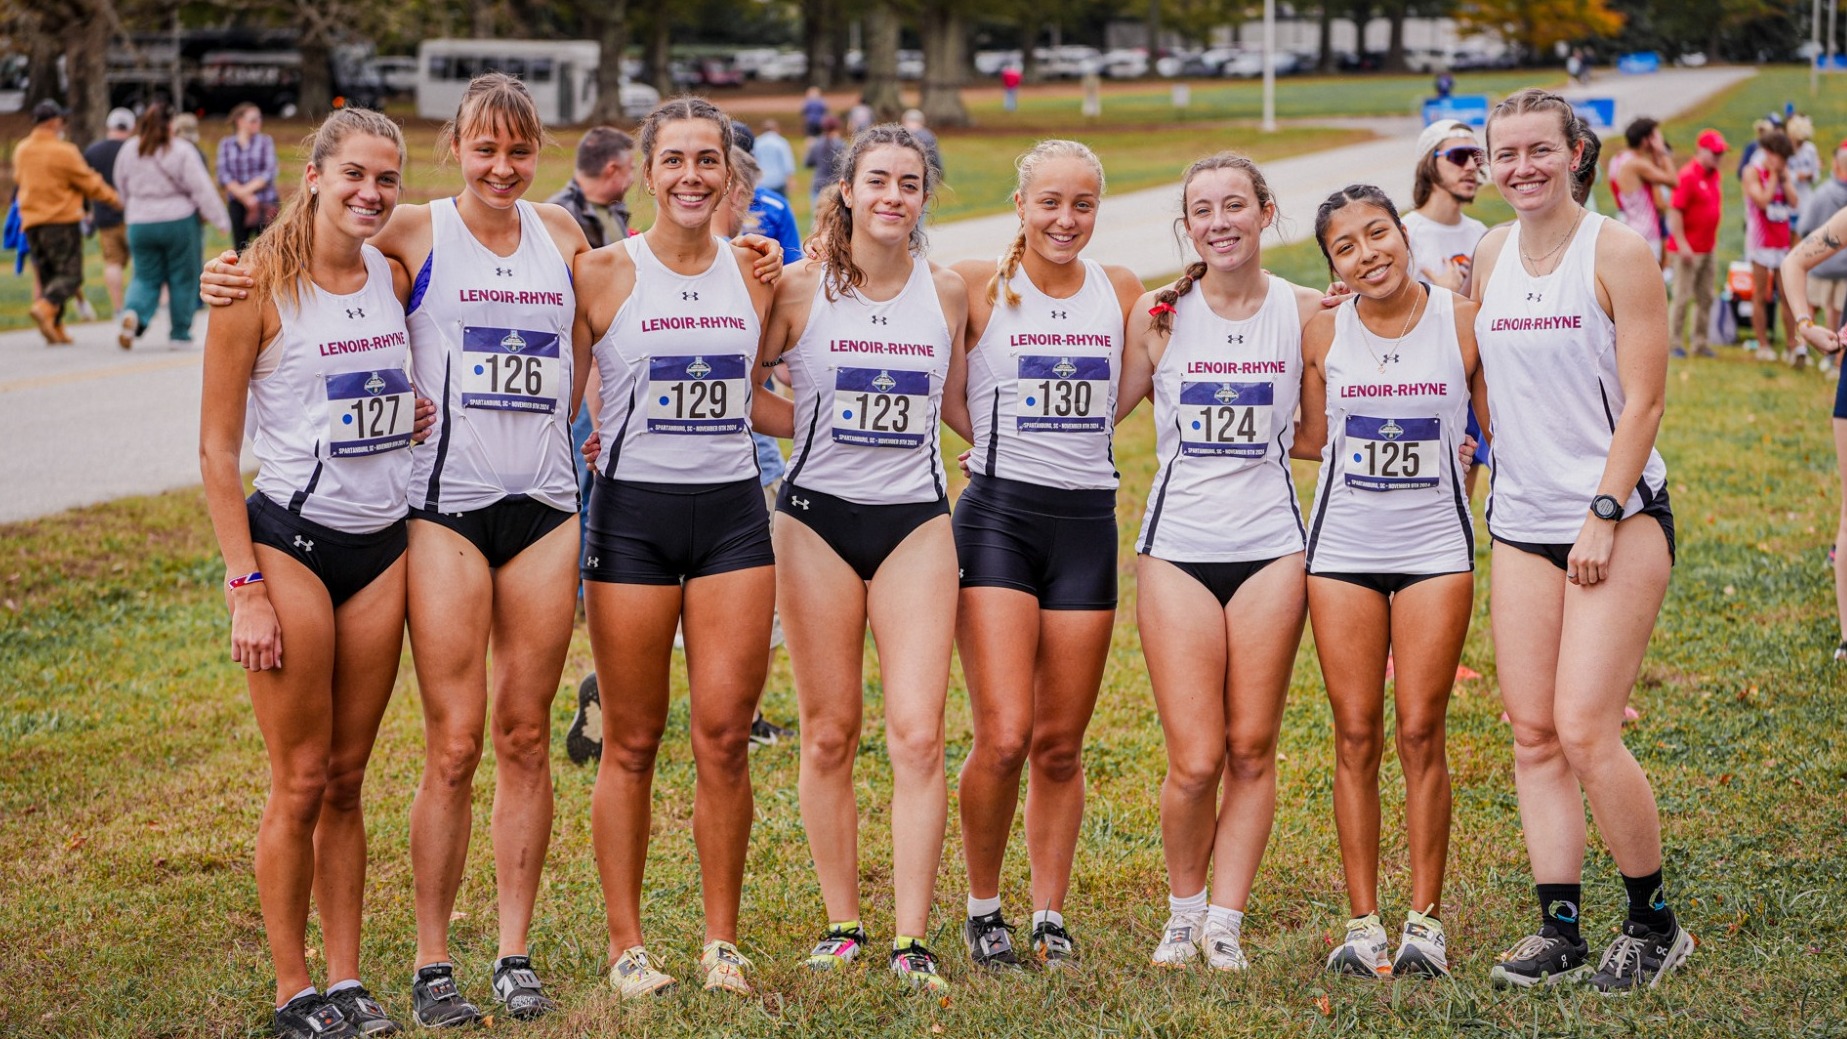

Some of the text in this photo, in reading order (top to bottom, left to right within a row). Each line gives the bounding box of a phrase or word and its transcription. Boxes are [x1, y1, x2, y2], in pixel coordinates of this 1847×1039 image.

[459, 289, 563, 306] LENOIR-RHYNE
[641, 316, 746, 332] LENOIR-RHYNE
[1491, 315, 1582, 331] LENOIR-RHYNE
[319, 332, 405, 357] LENOIR-RHYNE
[830, 340, 935, 357] LENOIR-RHYNE
[1010, 334, 1112, 347] LENOIR-RHYNE
[485, 354, 542, 396] 126
[1187, 361, 1286, 374] LENOIR-RHYNE
[671, 380, 727, 418] 129
[1039, 380, 1091, 416] 130
[1340, 383, 1447, 398] LENOIR-RHYNE
[351, 395, 400, 438] 127
[856, 393, 910, 432] 123
[1200, 406, 1256, 442] 124
[1364, 441, 1420, 477] 125
